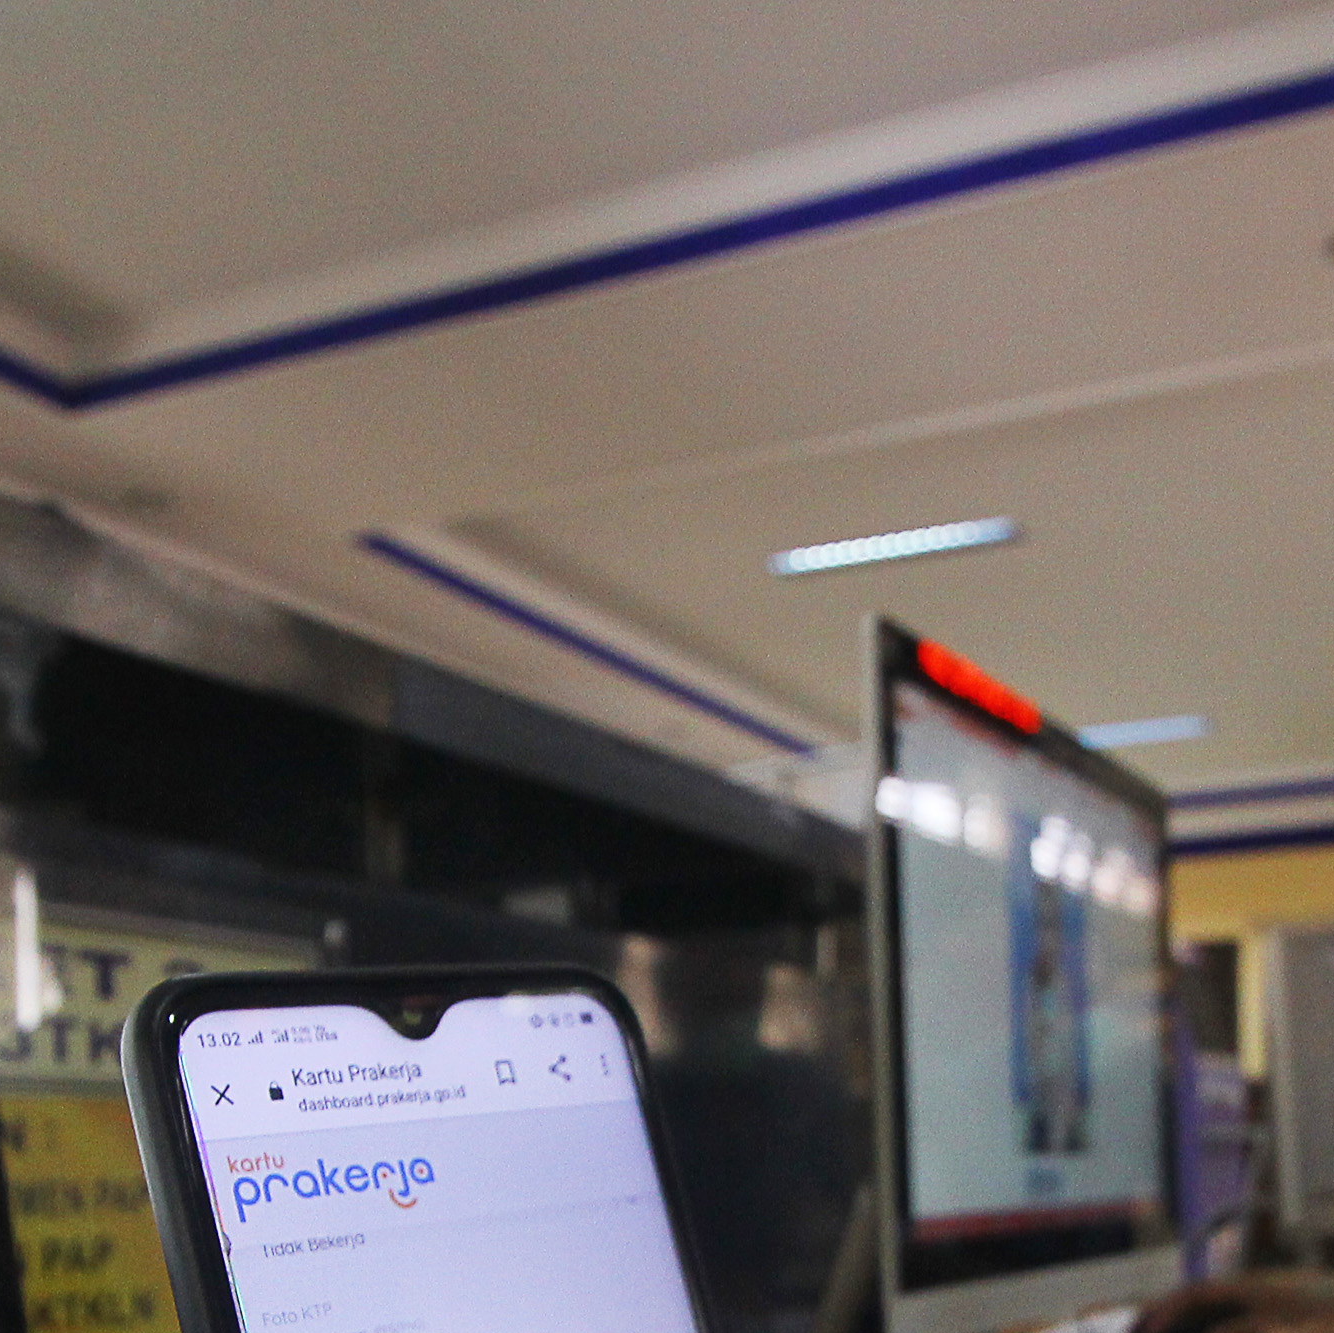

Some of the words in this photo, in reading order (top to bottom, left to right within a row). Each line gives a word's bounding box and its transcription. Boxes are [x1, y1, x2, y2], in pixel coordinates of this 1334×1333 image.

[197, 1032, 242, 1048] 13.02
[291, 1068, 344, 1087] Kartu
[347, 1061, 423, 1082] Prakerja
[298, 1084, 467, 1113] dashboard.prakerja.go.id
[226, 1151, 285, 1175] kartu
[232, 1156, 436, 1224] prakerja
[262, 1238, 305, 1259] Tidak
[306, 1230, 366, 1253] Bekerja
[261, 1308, 298, 1328] Foto
[300, 1301, 333, 1321] KTP
